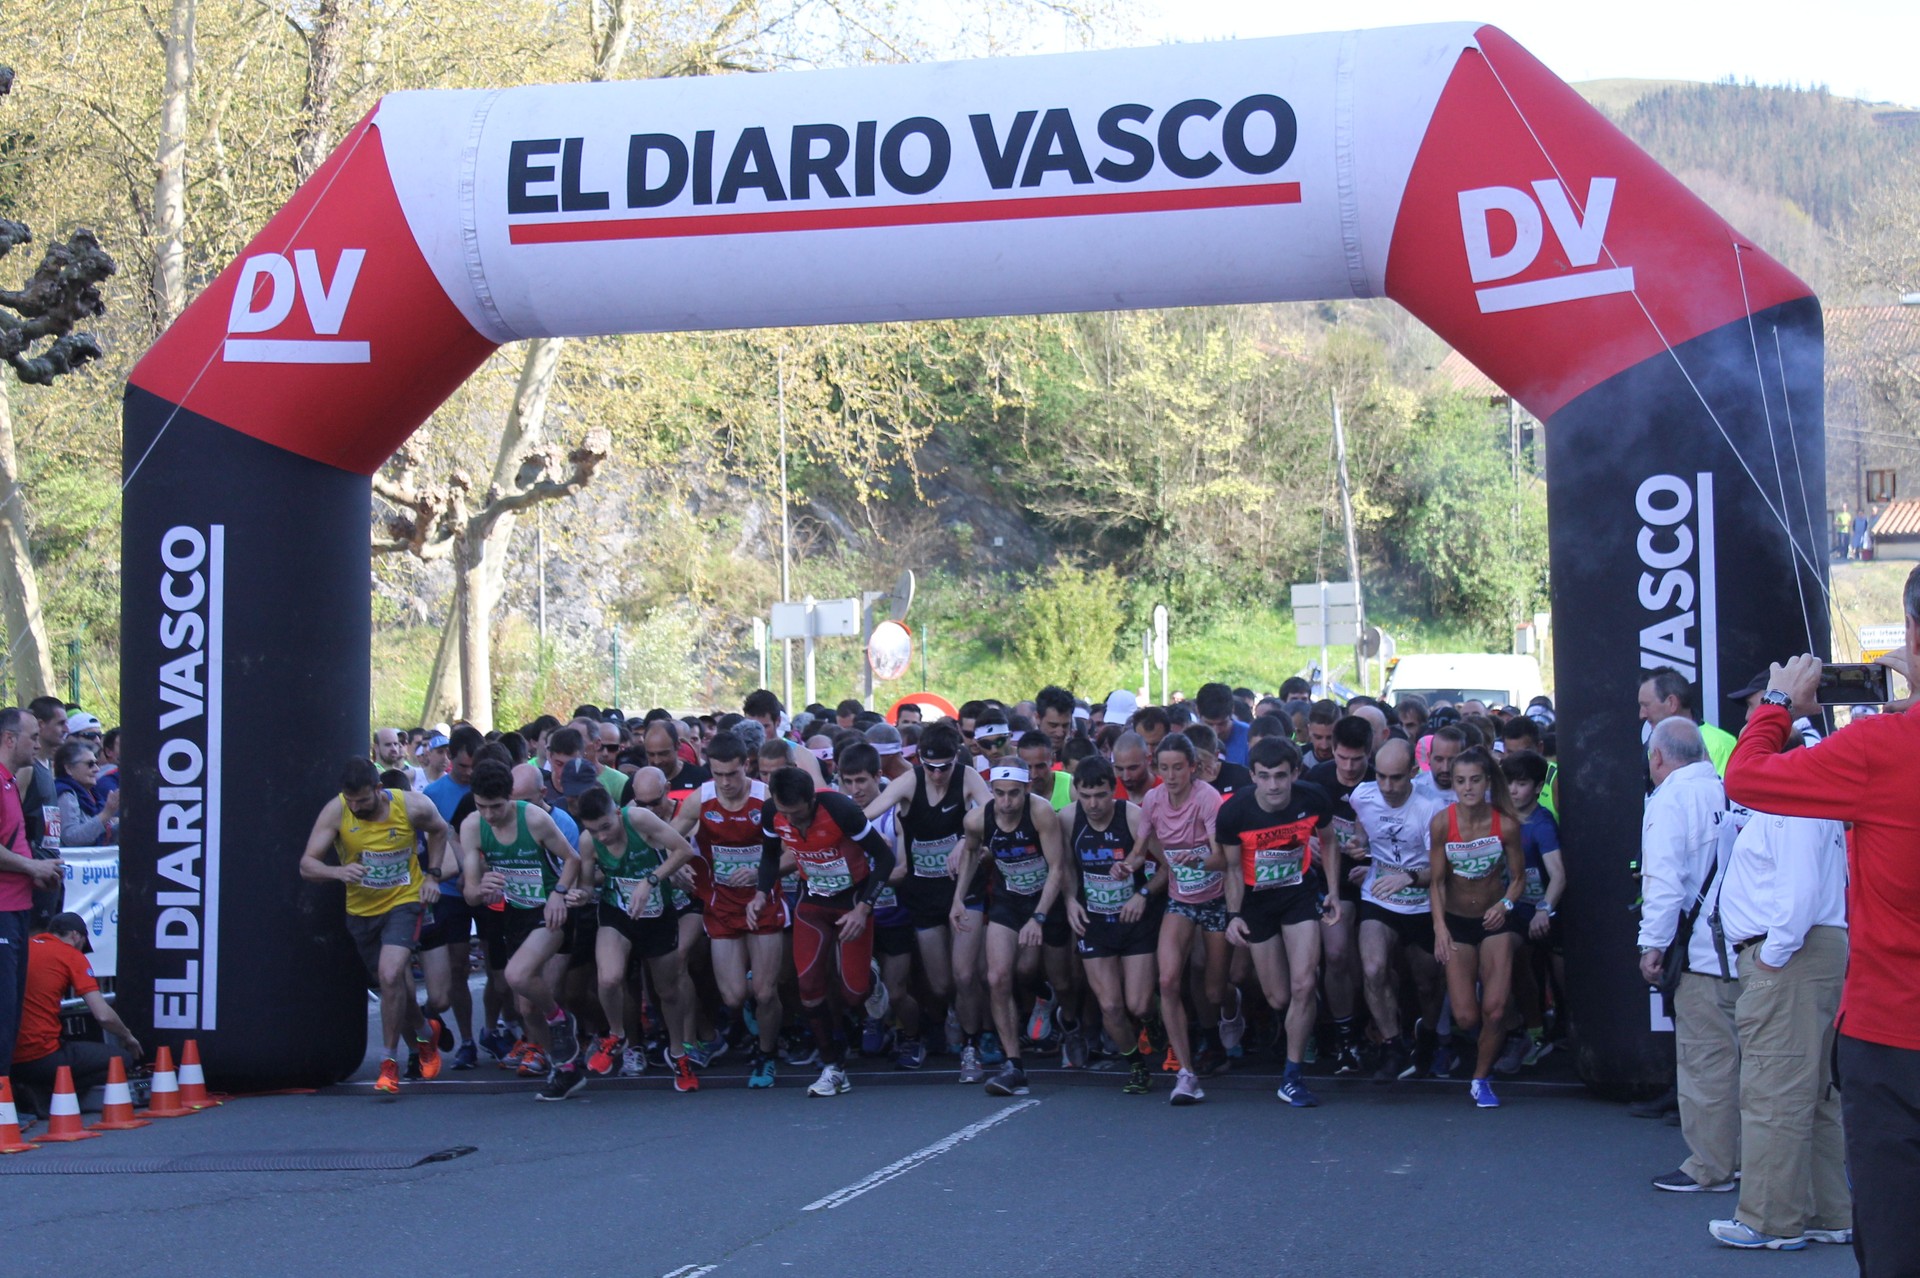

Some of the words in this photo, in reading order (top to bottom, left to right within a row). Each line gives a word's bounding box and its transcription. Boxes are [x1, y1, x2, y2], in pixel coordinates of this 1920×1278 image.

[508, 137, 609, 214] EL
[626, 116, 952, 208] DIARIO
[968, 93, 1298, 190] VASCO
[1457, 176, 1617, 284] DV
[227, 248, 366, 335] DV
[159, 525, 206, 731] VASCO
[155, 738, 204, 950] DIARIO
[913, 853, 948, 867] 200
[1456, 841, 1477, 849] DIARIO
[1477, 837, 1498, 846] VASCO
[82, 859, 119, 885] gipuz
[367, 860, 409, 878] 2322
[1171, 867, 1205, 881] 225
[1086, 888, 1134, 904] 2048
[153, 960, 199, 1030] EL
